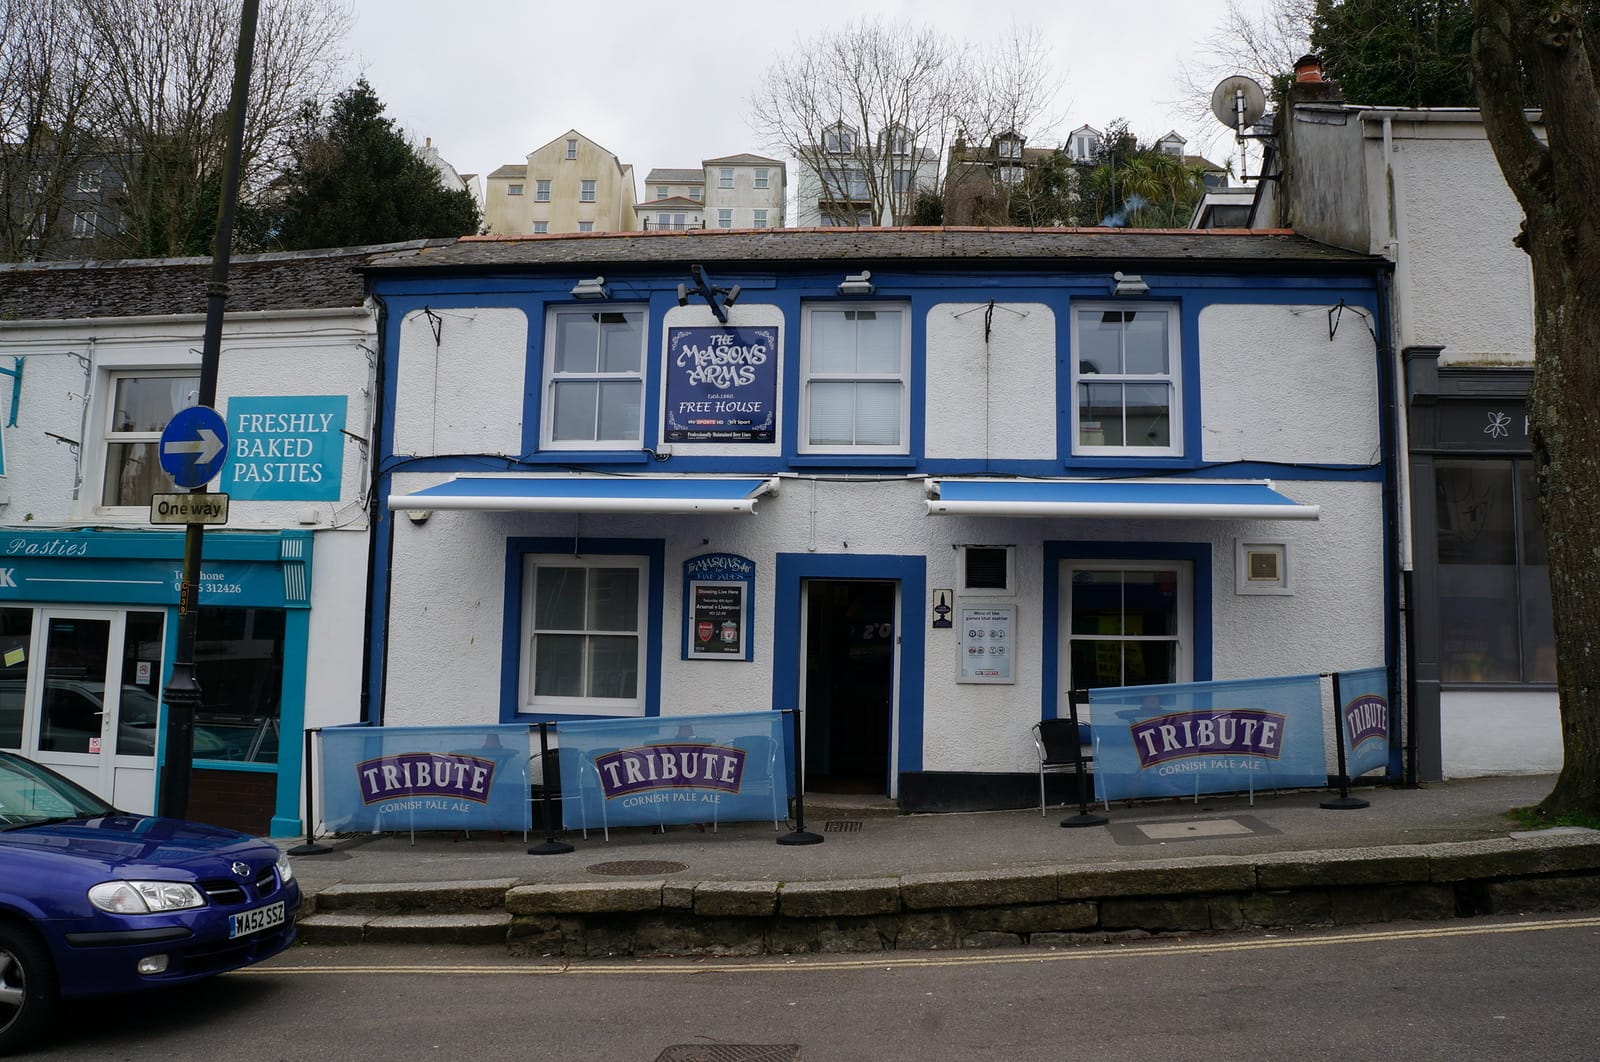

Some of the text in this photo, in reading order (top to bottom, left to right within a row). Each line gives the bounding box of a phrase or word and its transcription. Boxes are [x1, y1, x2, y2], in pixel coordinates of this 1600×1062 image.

[710, 335, 735, 345] THE
[677, 344, 767, 367] MASONS
[686, 365, 755, 389] ARMS
[680, 401, 762, 413] FREE HOUSE
[238, 413, 334, 433] FRESHLY
[236, 438, 313, 458] BAKED
[233, 463, 322, 483] PASTIES
[158, 501, 222, 518] One way
[6, 538, 88, 556] Pasties
[206, 583, 242, 593] 312426
[1348, 703, 1386, 739] TRIBUTE
[1139, 718, 1278, 757] TRIBUTE
[363, 761, 488, 794] TRIBUTE
[604, 752, 738, 789] TRIBUTE
[1159, 759, 1262, 777] CORNISH PALE ALE
[379, 801, 470, 814] CORNISH PALE ALE
[623, 793, 721, 808] CORNISH PALE ALE
[266, 904, 283, 925] SSZ
